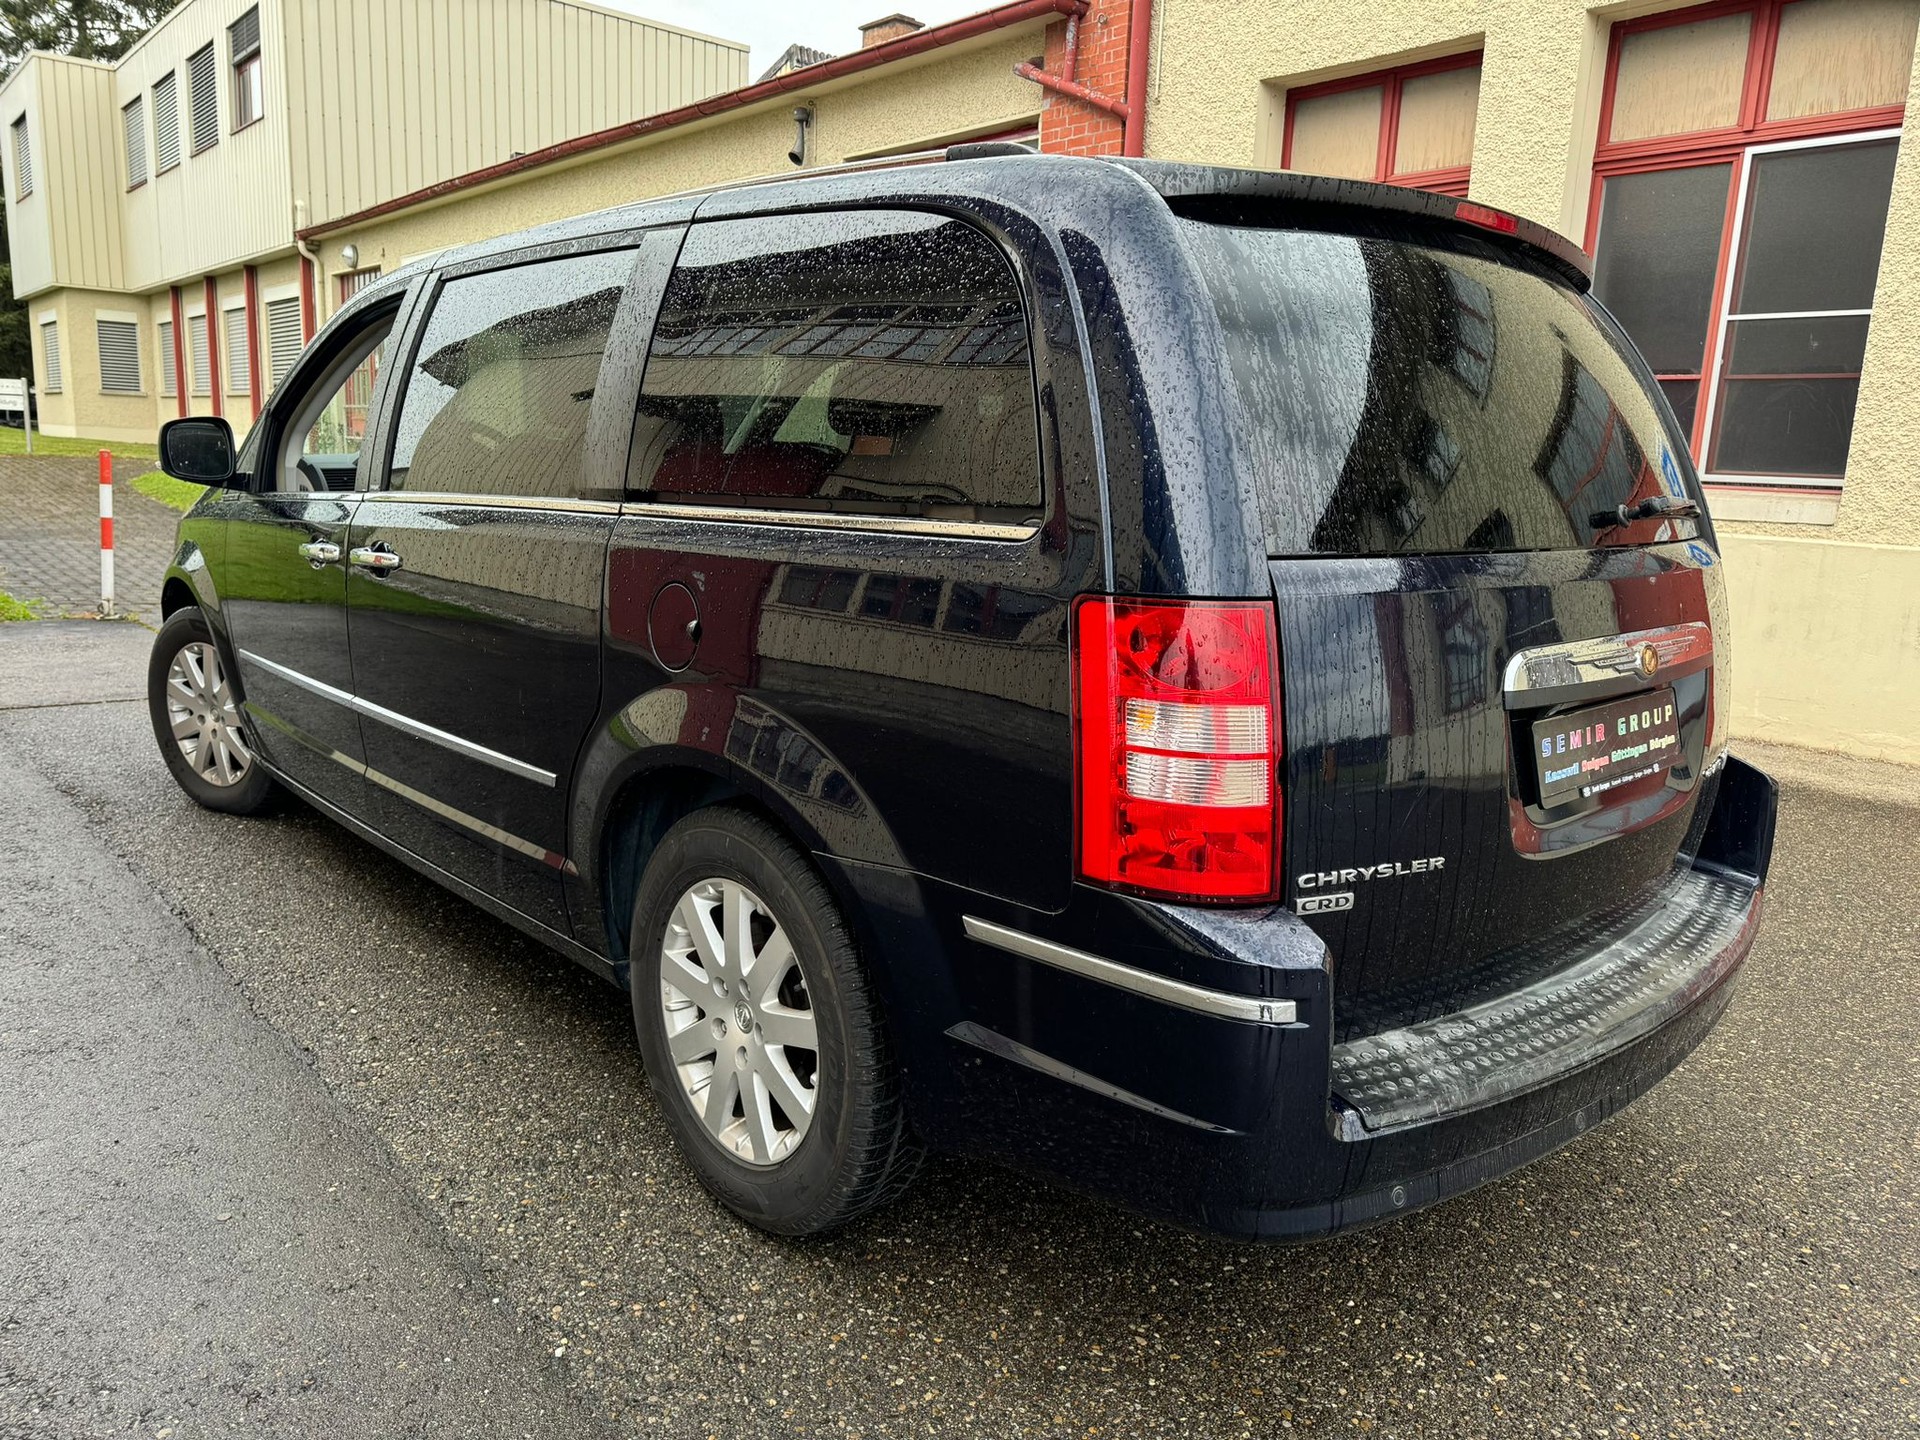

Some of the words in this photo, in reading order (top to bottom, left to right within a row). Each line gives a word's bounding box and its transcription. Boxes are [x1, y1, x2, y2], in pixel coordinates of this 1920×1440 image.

[1541, 723, 1605, 758] SEMIR
[1617, 704, 1673, 736] GROUP
[1297, 856, 1446, 889] CHRYSLER
[1301, 896, 1350, 912] CRD
